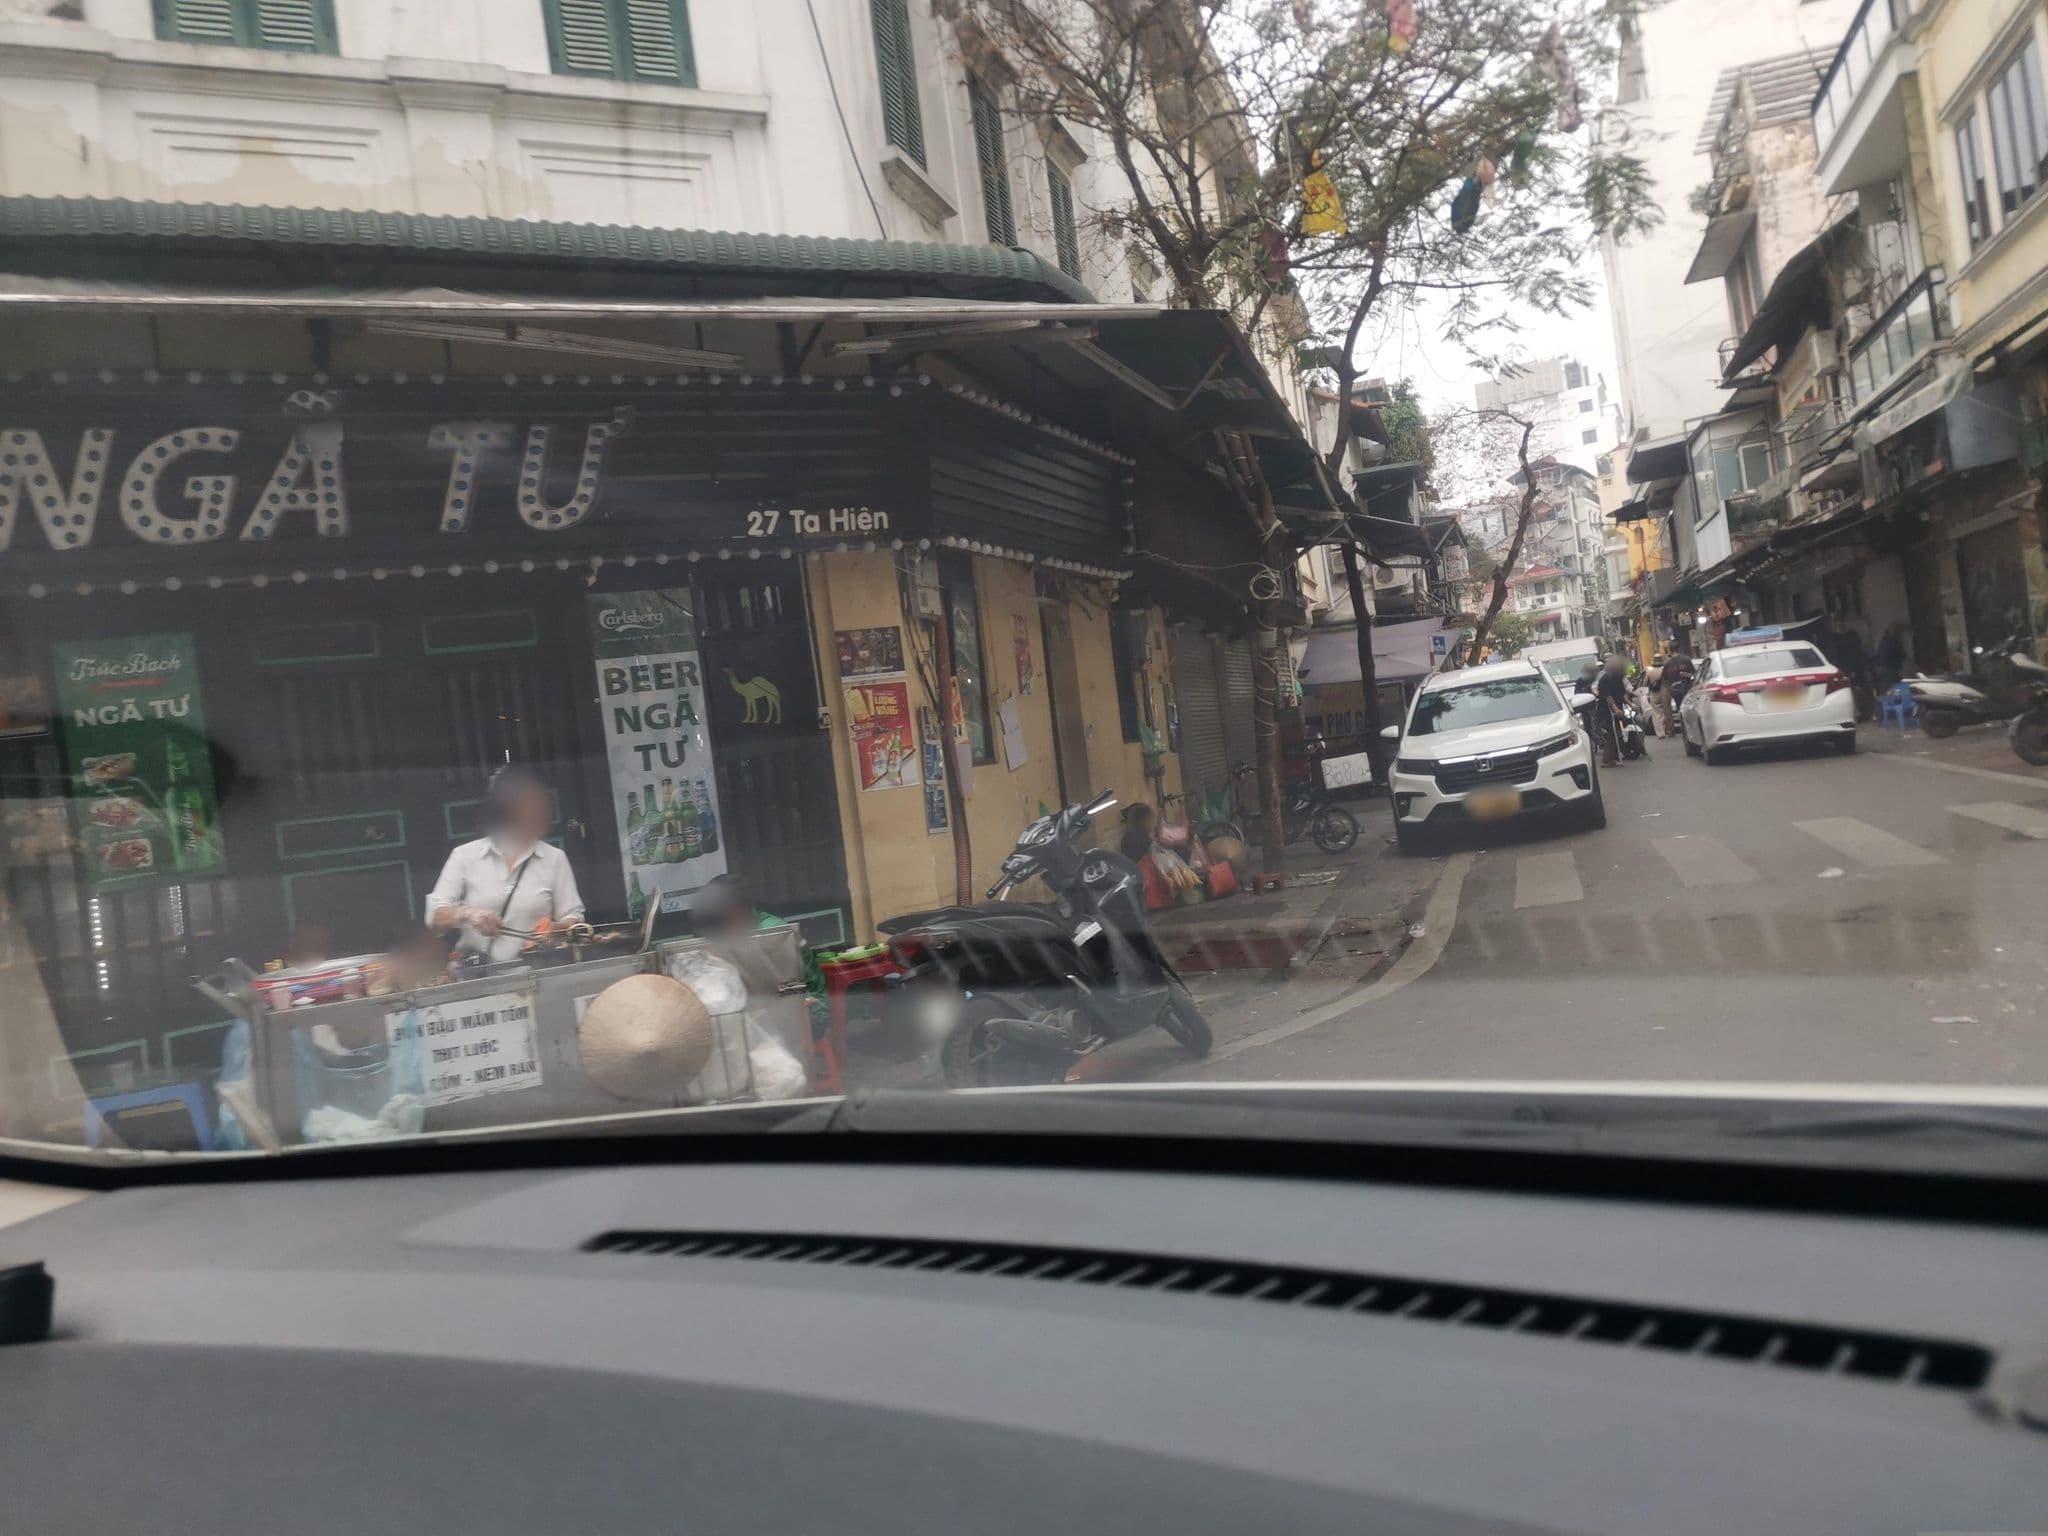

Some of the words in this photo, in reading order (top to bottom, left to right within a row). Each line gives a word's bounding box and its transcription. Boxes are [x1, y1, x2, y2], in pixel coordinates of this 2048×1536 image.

[0, 390, 351, 551] NGÃ
[746, 510, 780, 537] 27
[829, 507, 889, 535] Hiện
[599, 607, 664, 632] Carlsberg
[604, 660, 700, 696] BEER
[74, 698, 144, 728] NGÃ
[148, 693, 191, 719] TƯ
[614, 693, 701, 734] NGÃ
[633, 734, 689, 771] TƯ
